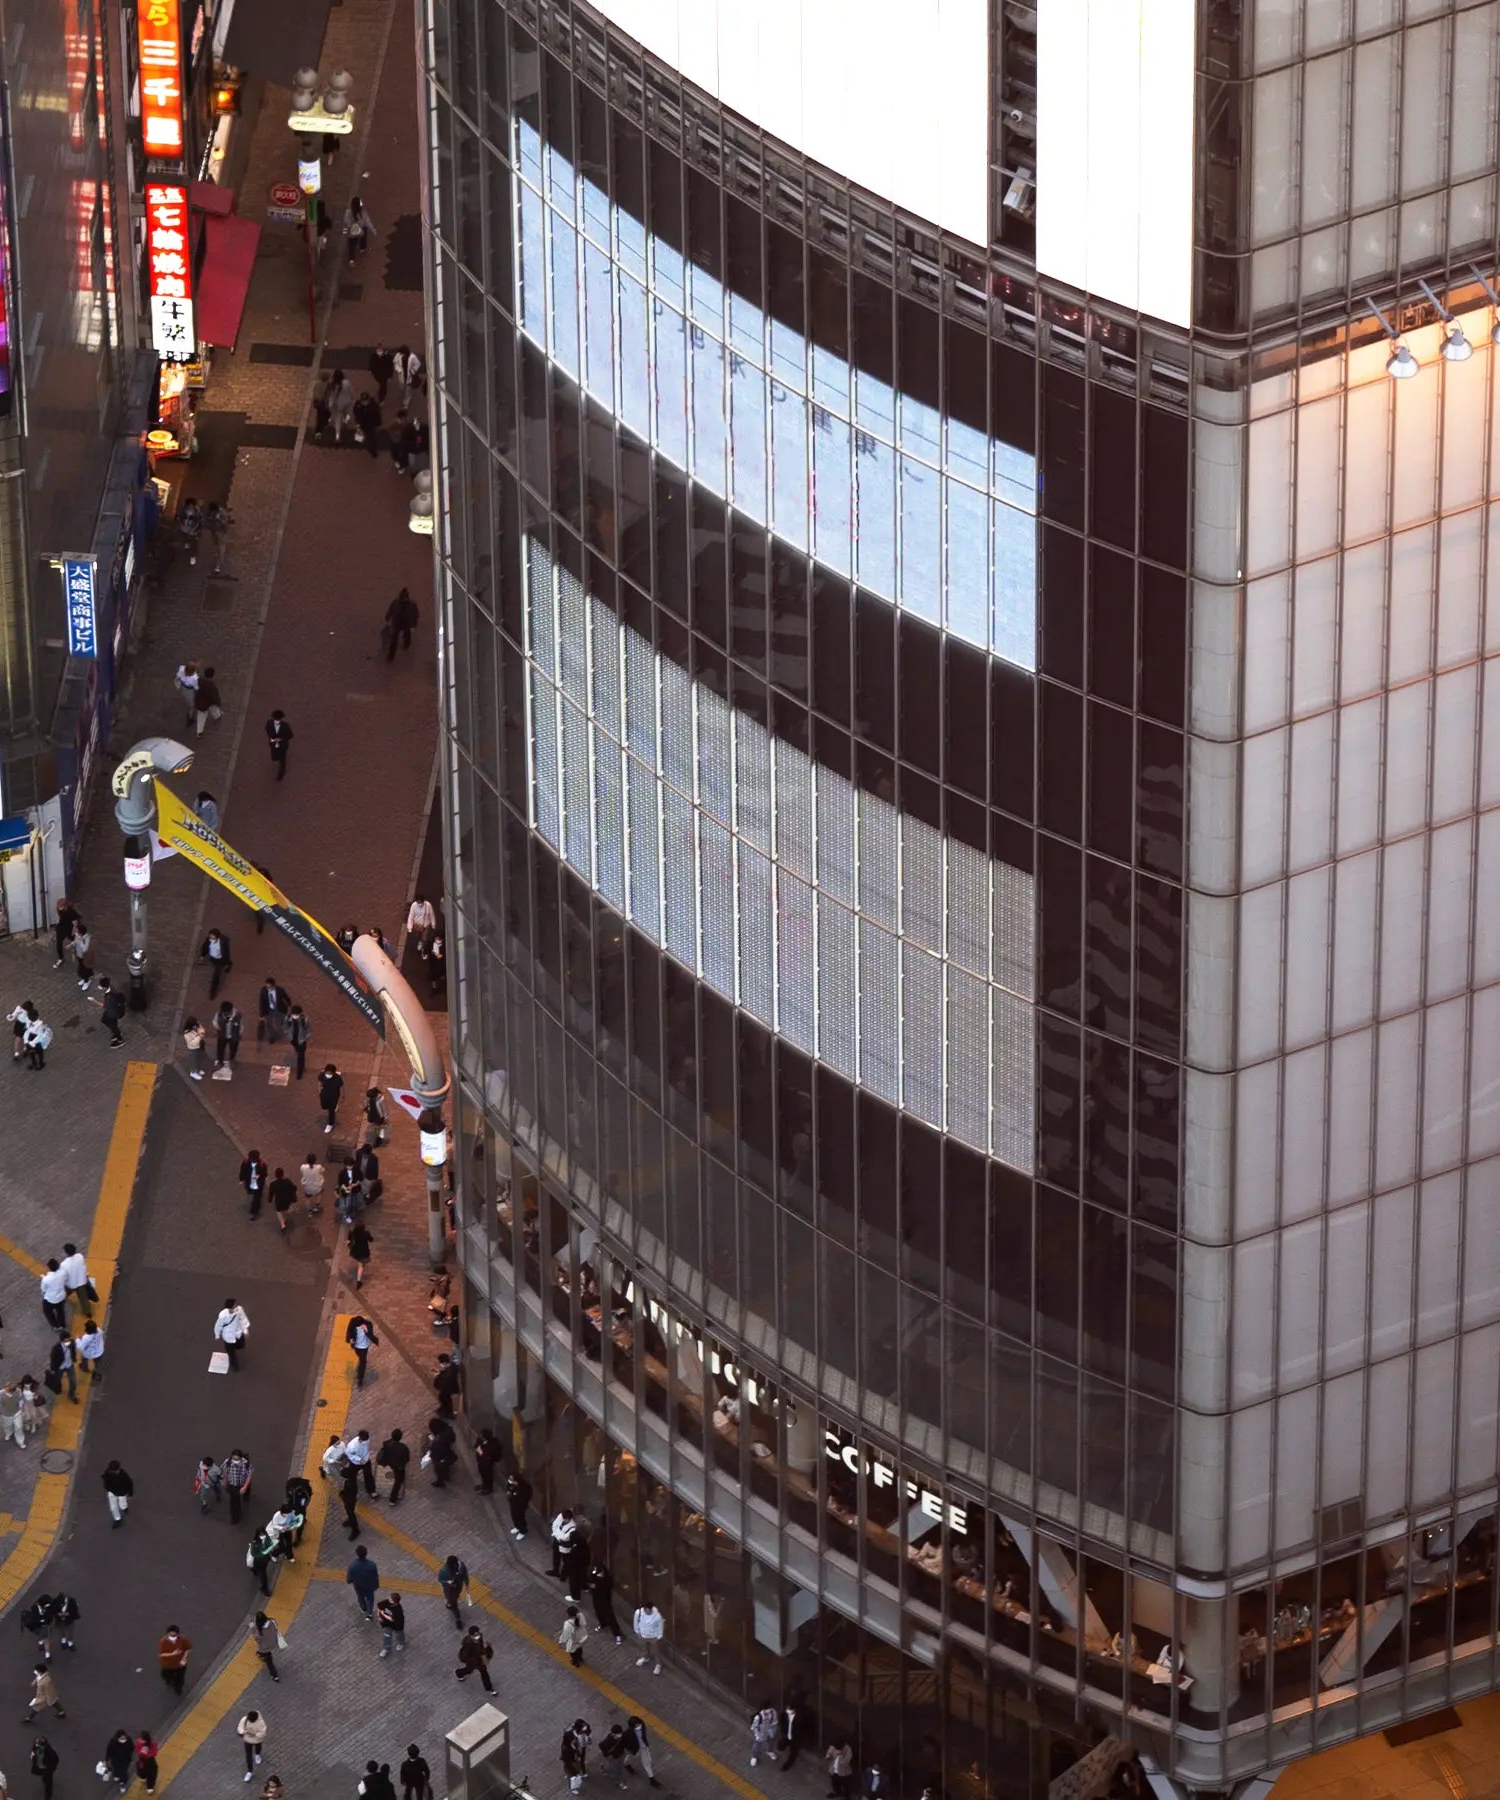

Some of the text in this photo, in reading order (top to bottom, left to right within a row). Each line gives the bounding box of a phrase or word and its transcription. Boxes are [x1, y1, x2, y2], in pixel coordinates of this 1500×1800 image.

[146, 0, 170, 27] ら
[69, 565, 93, 653] 大盛堂商事ビル
[825, 1431, 968, 1535] COFFEE
